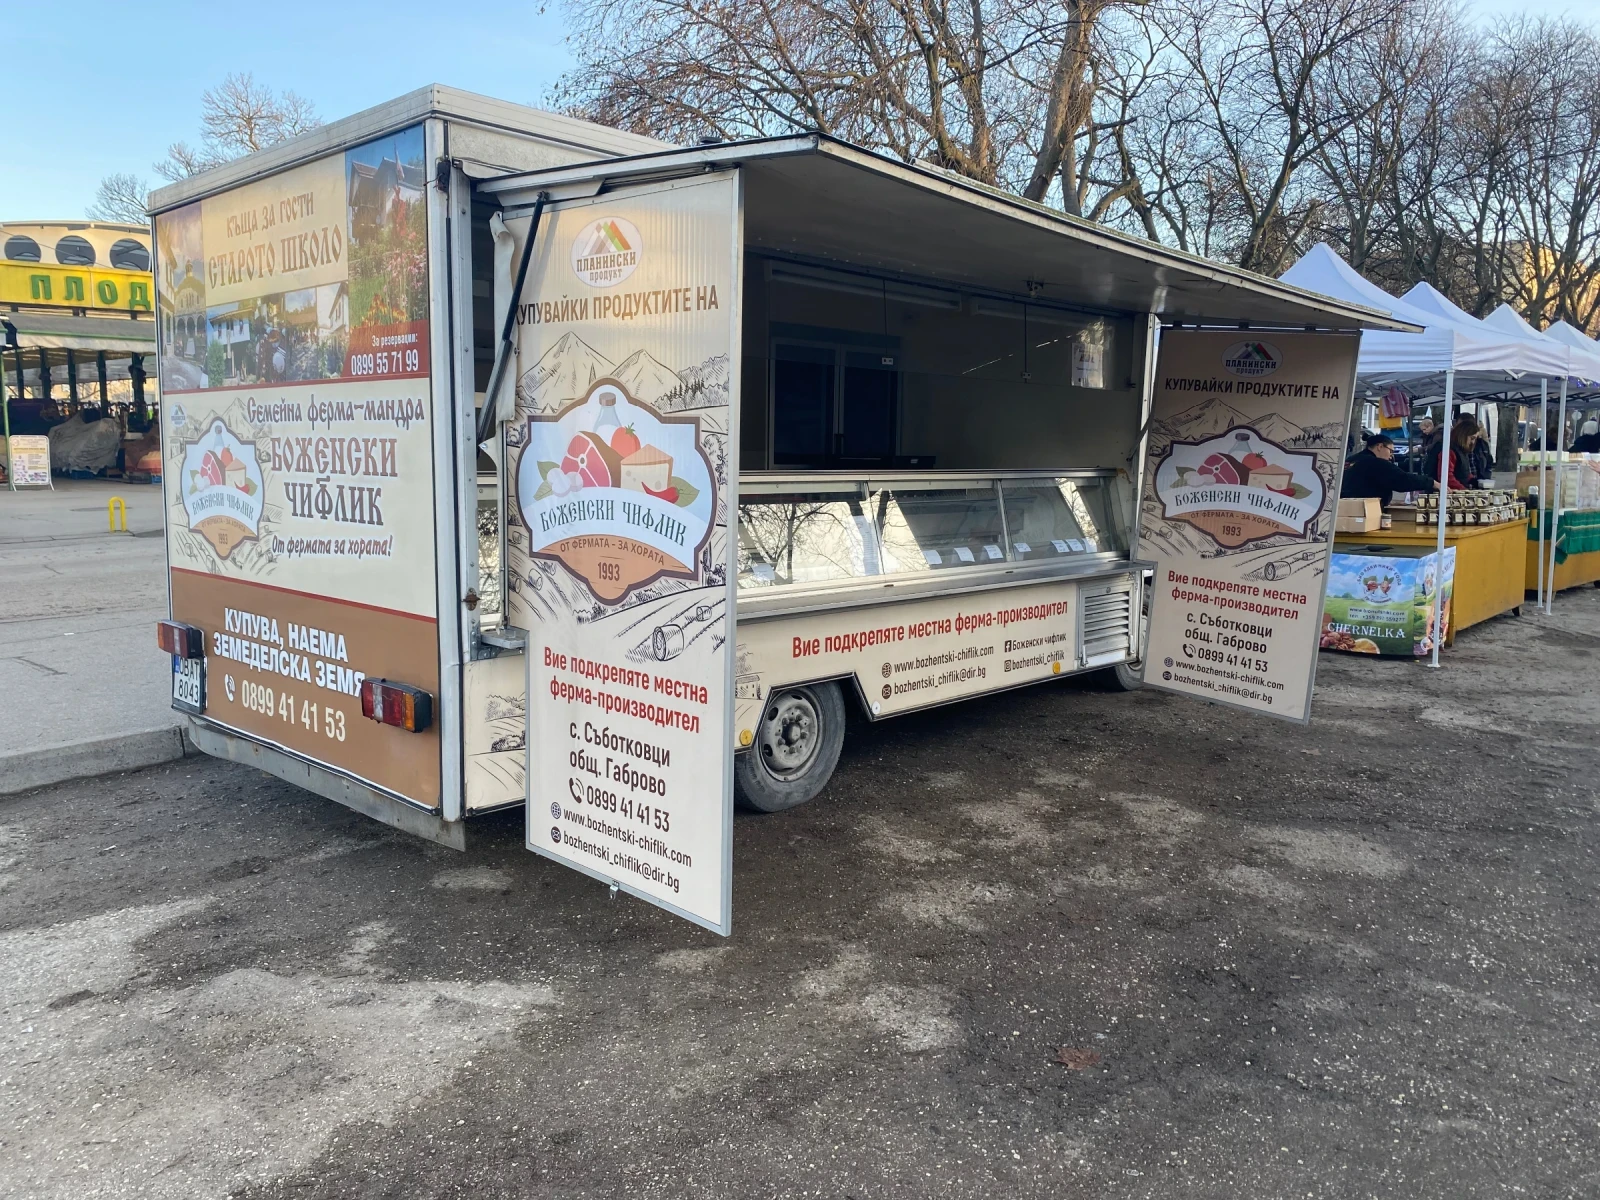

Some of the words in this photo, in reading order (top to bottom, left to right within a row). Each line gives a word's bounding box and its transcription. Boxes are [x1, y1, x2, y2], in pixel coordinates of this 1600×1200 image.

[227, 209, 258, 239] КЪЩА
[261, 206, 276, 230] ЗА
[280, 192, 314, 223] ГОСТИ
[208, 240, 276, 290] СТАРОТО
[281, 224, 342, 274] ШКОЛО
[576, 251, 636, 273] ПЛАНИНСКИ
[589, 268, 623, 283] продукт
[593, 287, 692, 321] ПРОДУКТИТЕ
[696, 284, 719, 311] НА
[371, 334, 380, 347] За
[381, 333, 418, 349] резервации:
[351, 353, 373, 376] 0899
[376, 352, 388, 374] 55
[391, 350, 402, 372] 71
[406, 348, 419, 372] 99
[1225, 359, 1277, 370] ПЛАНИНСКИ
[1165, 377, 1233, 394] КУПУВАЙКИ
[1236, 381, 1318, 398] ПРОДУКТИТЕ
[1322, 386, 1339, 400] НА
[247, 396, 303, 424] Семейна
[307, 394, 425, 431] ферма-мандра
[270, 436, 398, 478] БОЖЕНСКИ
[284, 476, 384, 526] ЧИФЛИК
[1174, 490, 1241, 507] БОЖЕНСКИ
[1247, 493, 1300, 521] ЧИФЛИК
[1240, 513, 1251, 521] ЗА
[540, 499, 615, 533] БОЖЕНСКИ
[622, 500, 688, 547] ЧИФЛИК
[1222, 525, 1242, 536] 1993
[271, 534, 285, 554] От
[286, 536, 332, 558] фермата
[334, 538, 346, 555] за
[559, 541, 570, 553] ОТ
[571, 537, 610, 549] ФЕРМАТА
[617, 540, 629, 552] ЗА
[630, 542, 665, 566] ХОРАТА
[597, 561, 620, 582] 1993
[1168, 570, 1189, 584] Вие
[1191, 576, 1260, 597] подкрепяте
[1262, 588, 1307, 605] местна
[1171, 587, 1299, 620] ферма-производител
[224, 607, 284, 651] КУПУВА,
[287, 622, 349, 663] НАЕМА
[792, 636, 820, 659] Вие
[824, 623, 905, 655] подкрепяте
[908, 617, 952, 642] местна
[954, 601, 1068, 636] ферма-производител
[1185, 627, 1213, 643] общ.
[1216, 632, 1267, 654] Габрово
[1186, 612, 1196, 623] с.
[1199, 612, 1273, 638] Съботковци
[1327, 622, 1406, 639] CHERNELKA
[213, 632, 312, 684] ЗЕМЕДЕЛСКА
[315, 660, 366, 698] ЗЕМЯ
[893, 644, 995, 673] www.bozhentski-chiflik.com
[1175, 659, 1284, 690] www.bozhentski-chiflik.com
[1197, 647, 1224, 663] 0899
[1226, 653, 1238, 667] 41
[1240, 656, 1252, 669] 41
[1255, 659, 1268, 673] 53
[178, 679, 199, 704] 8043
[544, 646, 567, 671] Вие
[570, 656, 650, 691] подкрепяте
[654, 675, 708, 705] местна
[893, 666, 986, 696] bozhentski_chiflik@dir.bg
[1173, 672, 1273, 705] bozhentski_chiflik@dir.bg
[241, 679, 275, 717] 0899
[278, 691, 295, 725] 41
[300, 698, 319, 733] 41
[325, 706, 346, 743] 53
[550, 675, 700, 734] ферма-производител
[569, 722, 581, 740] с.
[584, 721, 671, 768] Съботковци
[569, 749, 602, 778] общ.
[605, 757, 666, 797] Габрово
[586, 785, 617, 814] 0899
[620, 797, 634, 820] 41
[636, 802, 650, 826] 41
[654, 808, 670, 833] 53
[563, 808, 692, 868] www.bozhentski-chiflik.com
[563, 830, 680, 894] bozhentski_chiflik@dir.bg
